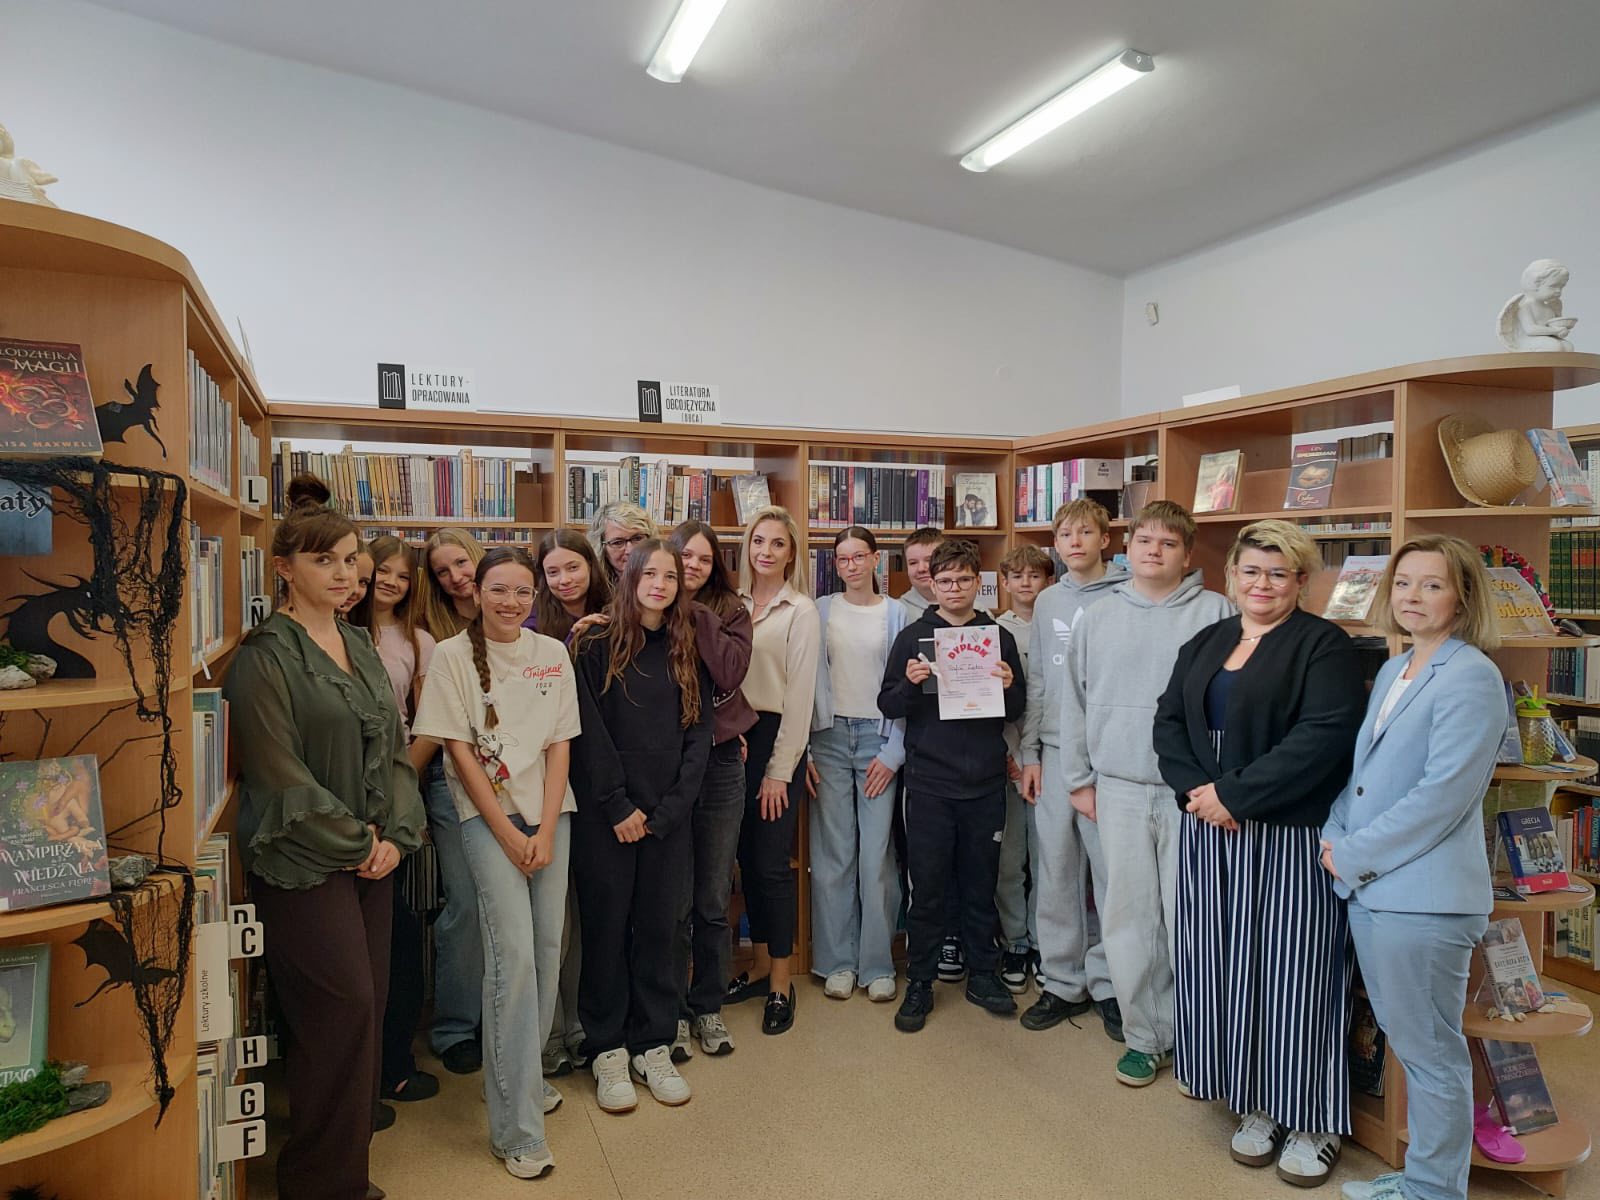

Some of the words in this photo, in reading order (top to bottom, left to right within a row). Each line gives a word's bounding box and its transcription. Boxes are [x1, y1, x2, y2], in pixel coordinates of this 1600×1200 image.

[14, 358, 80, 374] MAGII
[412, 389, 470, 404] OPRACOWANIA
[669, 384, 711, 398] LITERATURA
[665, 398, 716, 412] OBCOJĘZYCZNA
[248, 479, 259, 503] L
[947, 643, 989, 660] DYPLOM
[522, 663, 562, 680] Original
[241, 927, 256, 955] C
[200, 1001, 211, 1032] Lektury
[242, 1039, 258, 1065] H
[240, 1088, 256, 1116] G
[243, 1126, 258, 1156] F
